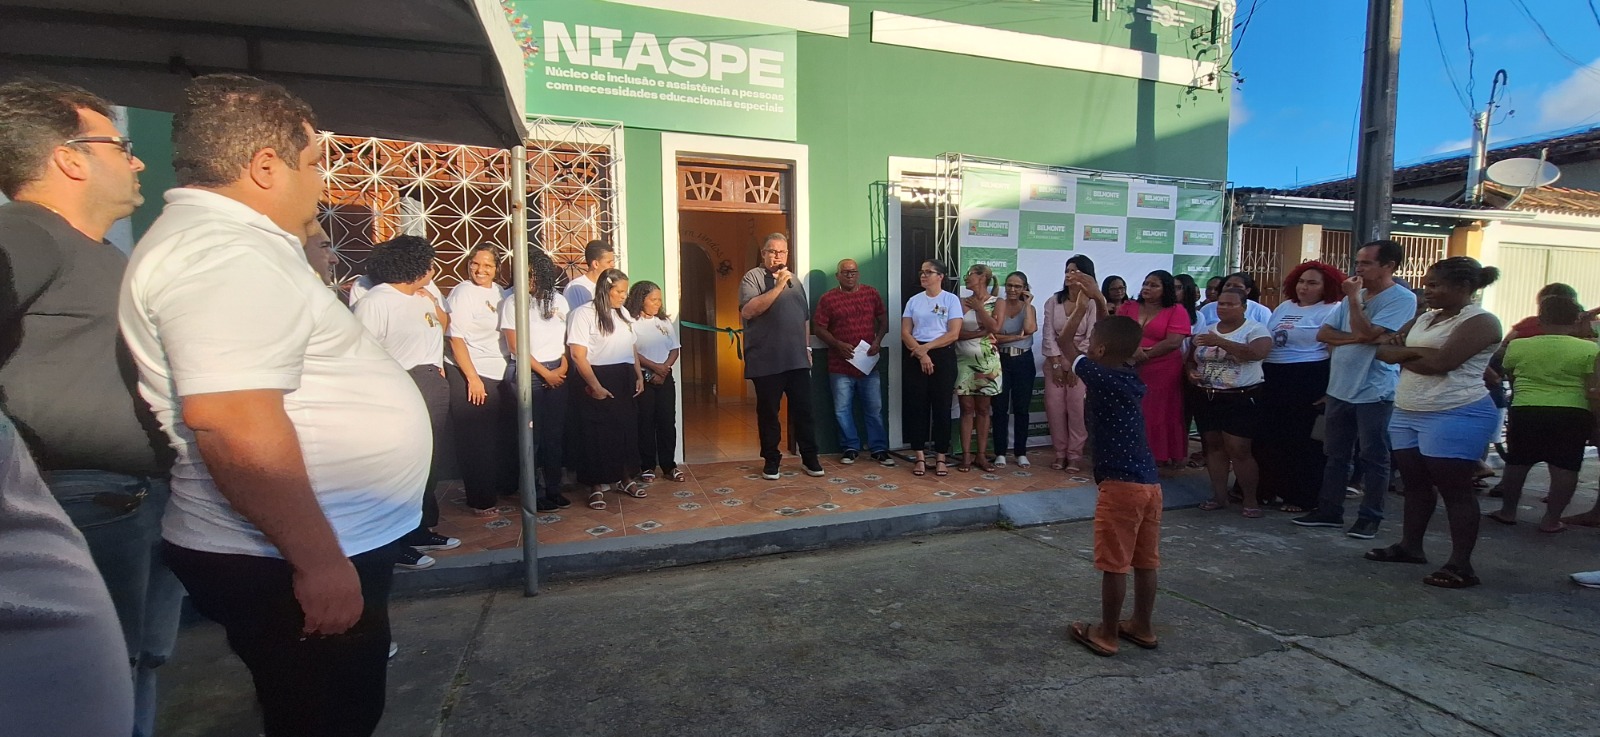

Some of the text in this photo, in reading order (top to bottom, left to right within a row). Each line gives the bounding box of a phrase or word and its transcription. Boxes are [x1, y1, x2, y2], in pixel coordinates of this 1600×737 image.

[543, 20, 784, 88] NIASPE
[545, 66, 589, 79] Núcleo
[590, 71, 605, 81] de
[607, 72, 656, 86] inclusão
[666, 81, 730, 95] assistência
[739, 89, 784, 101] pessoas
[545, 81, 784, 113] com necessidades educacionais especiais
[1038, 186, 1067, 194] BELMONTE
[1093, 190, 1120, 199] BELMONTE
[1191, 198, 1215, 206] BELMONTE
[978, 221, 1009, 229] BELMONTE
[1036, 224, 1066, 232] BELMONTE
[1091, 227, 1118, 235] BELMONTE
